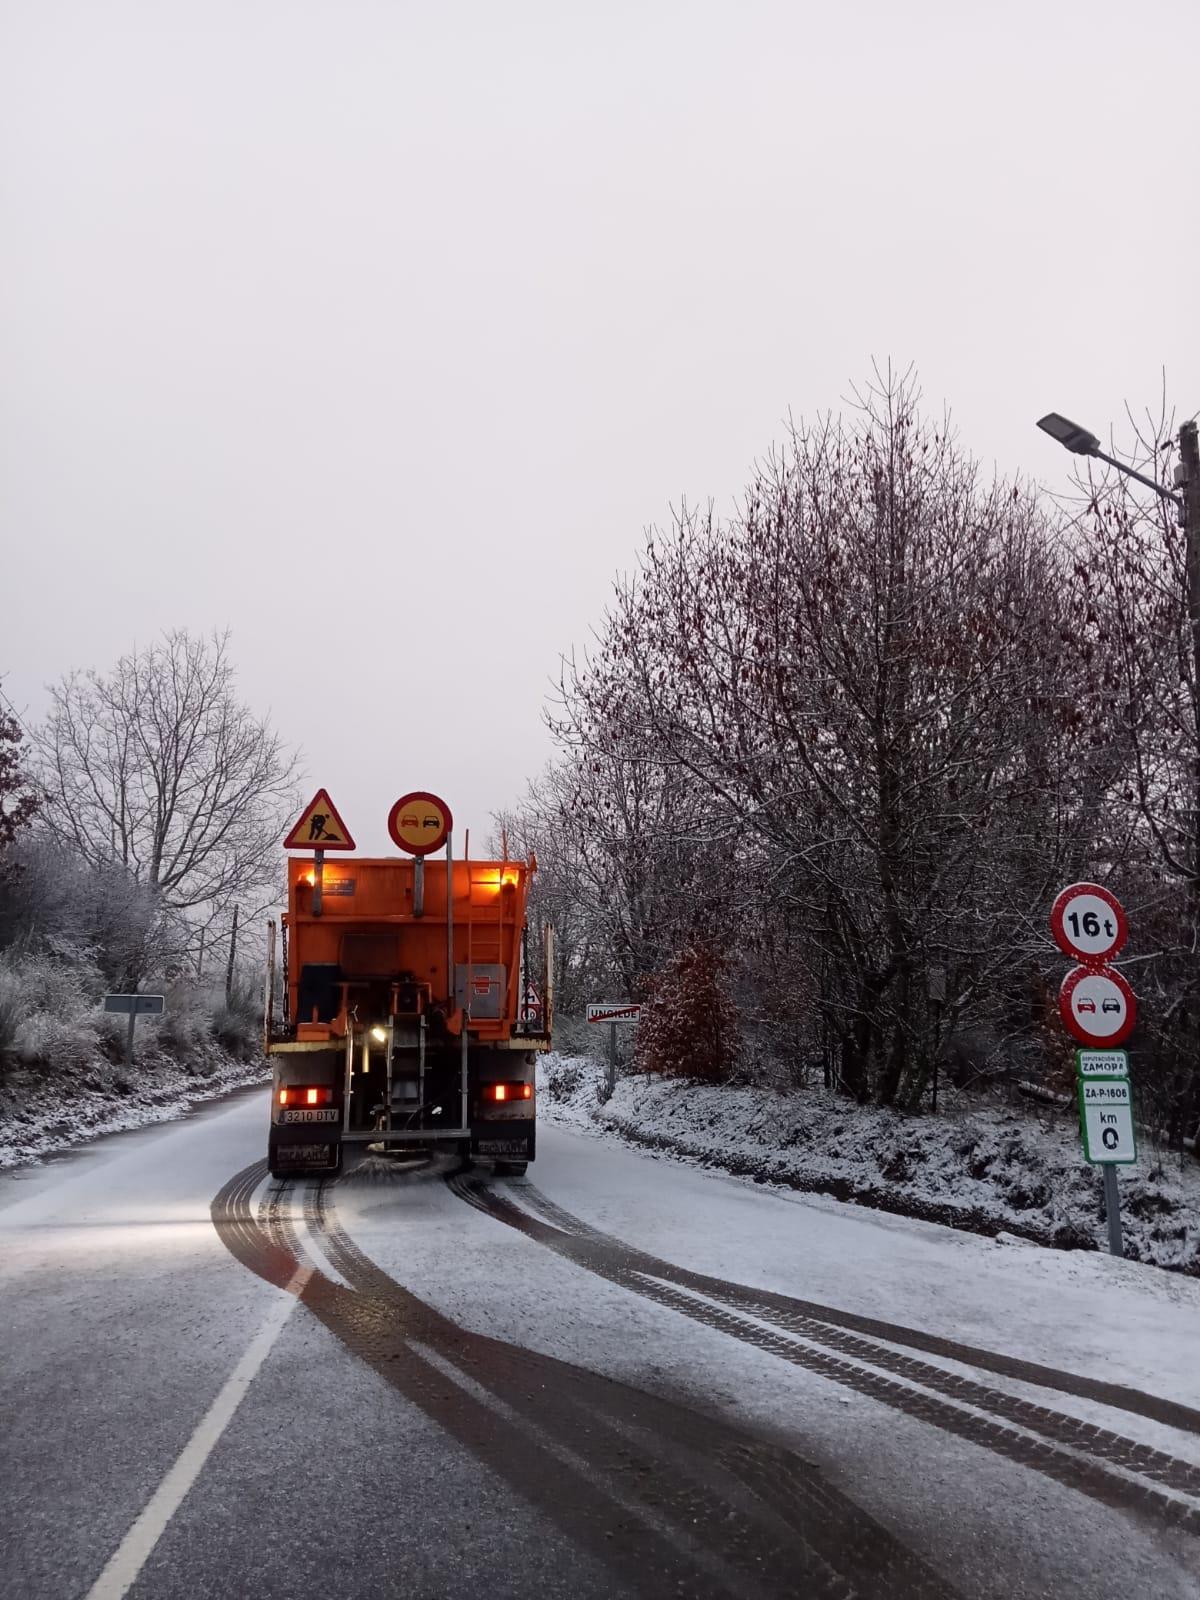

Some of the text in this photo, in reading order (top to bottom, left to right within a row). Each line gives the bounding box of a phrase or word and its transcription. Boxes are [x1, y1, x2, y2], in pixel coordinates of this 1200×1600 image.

[287, 1111, 336, 1121] 3210 DTV
[1100, 1112, 1117, 1124] km
[1102, 1127, 1119, 1150] 0
